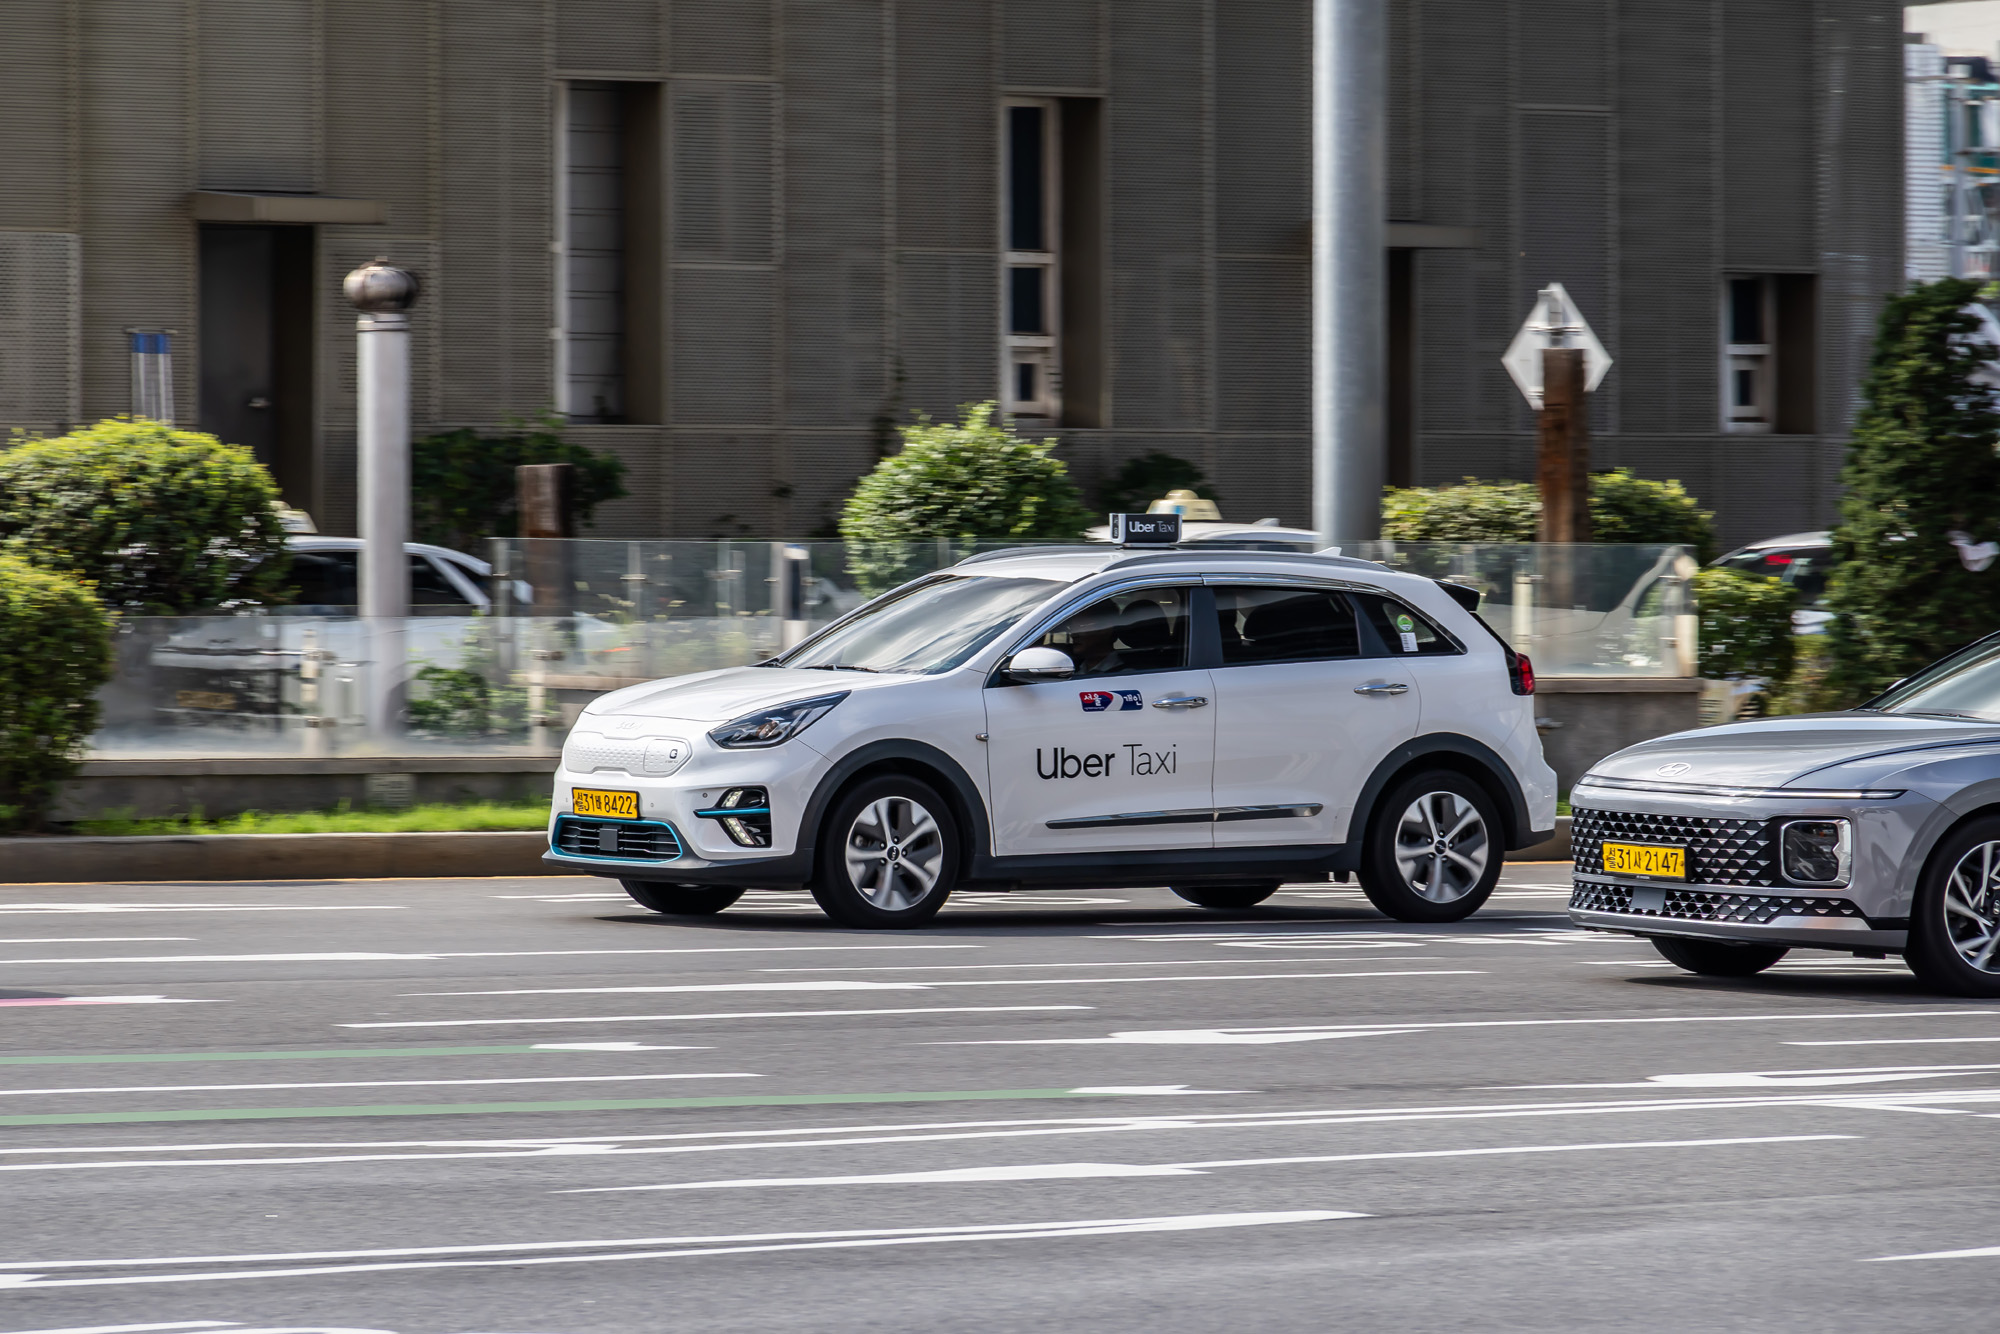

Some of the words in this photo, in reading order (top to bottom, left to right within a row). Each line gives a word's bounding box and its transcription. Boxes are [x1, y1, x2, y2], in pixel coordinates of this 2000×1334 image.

[1128, 521, 1155, 533] Uber
[1157, 520, 1175, 533] Taxi
[1084, 693, 1102, 707] 서울
[1123, 693, 1143, 706] 개인
[1036, 747, 1116, 780] Uber
[1122, 743, 1177, 776] Taxi
